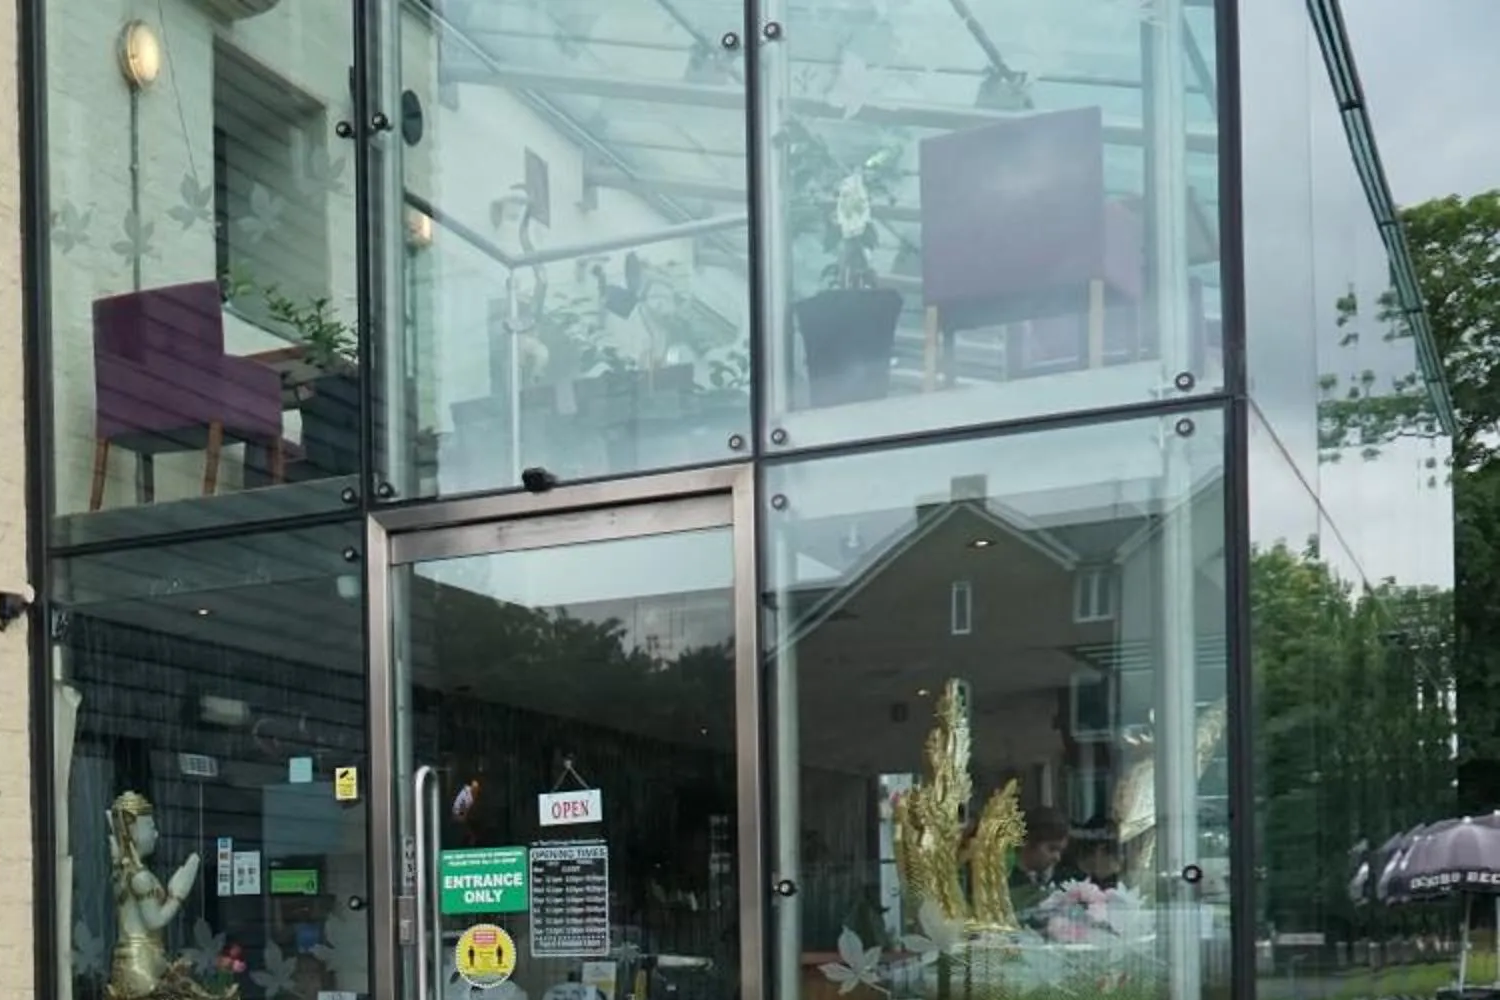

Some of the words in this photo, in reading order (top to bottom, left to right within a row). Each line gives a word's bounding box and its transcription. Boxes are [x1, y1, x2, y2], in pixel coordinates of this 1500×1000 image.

[552, 800, 589, 819] OPEN
[532, 848, 574, 860] OPENING
[576, 847, 606, 858] TIMES
[445, 873, 523, 889] ENTRANCE
[464, 890, 503, 903] ONLY
